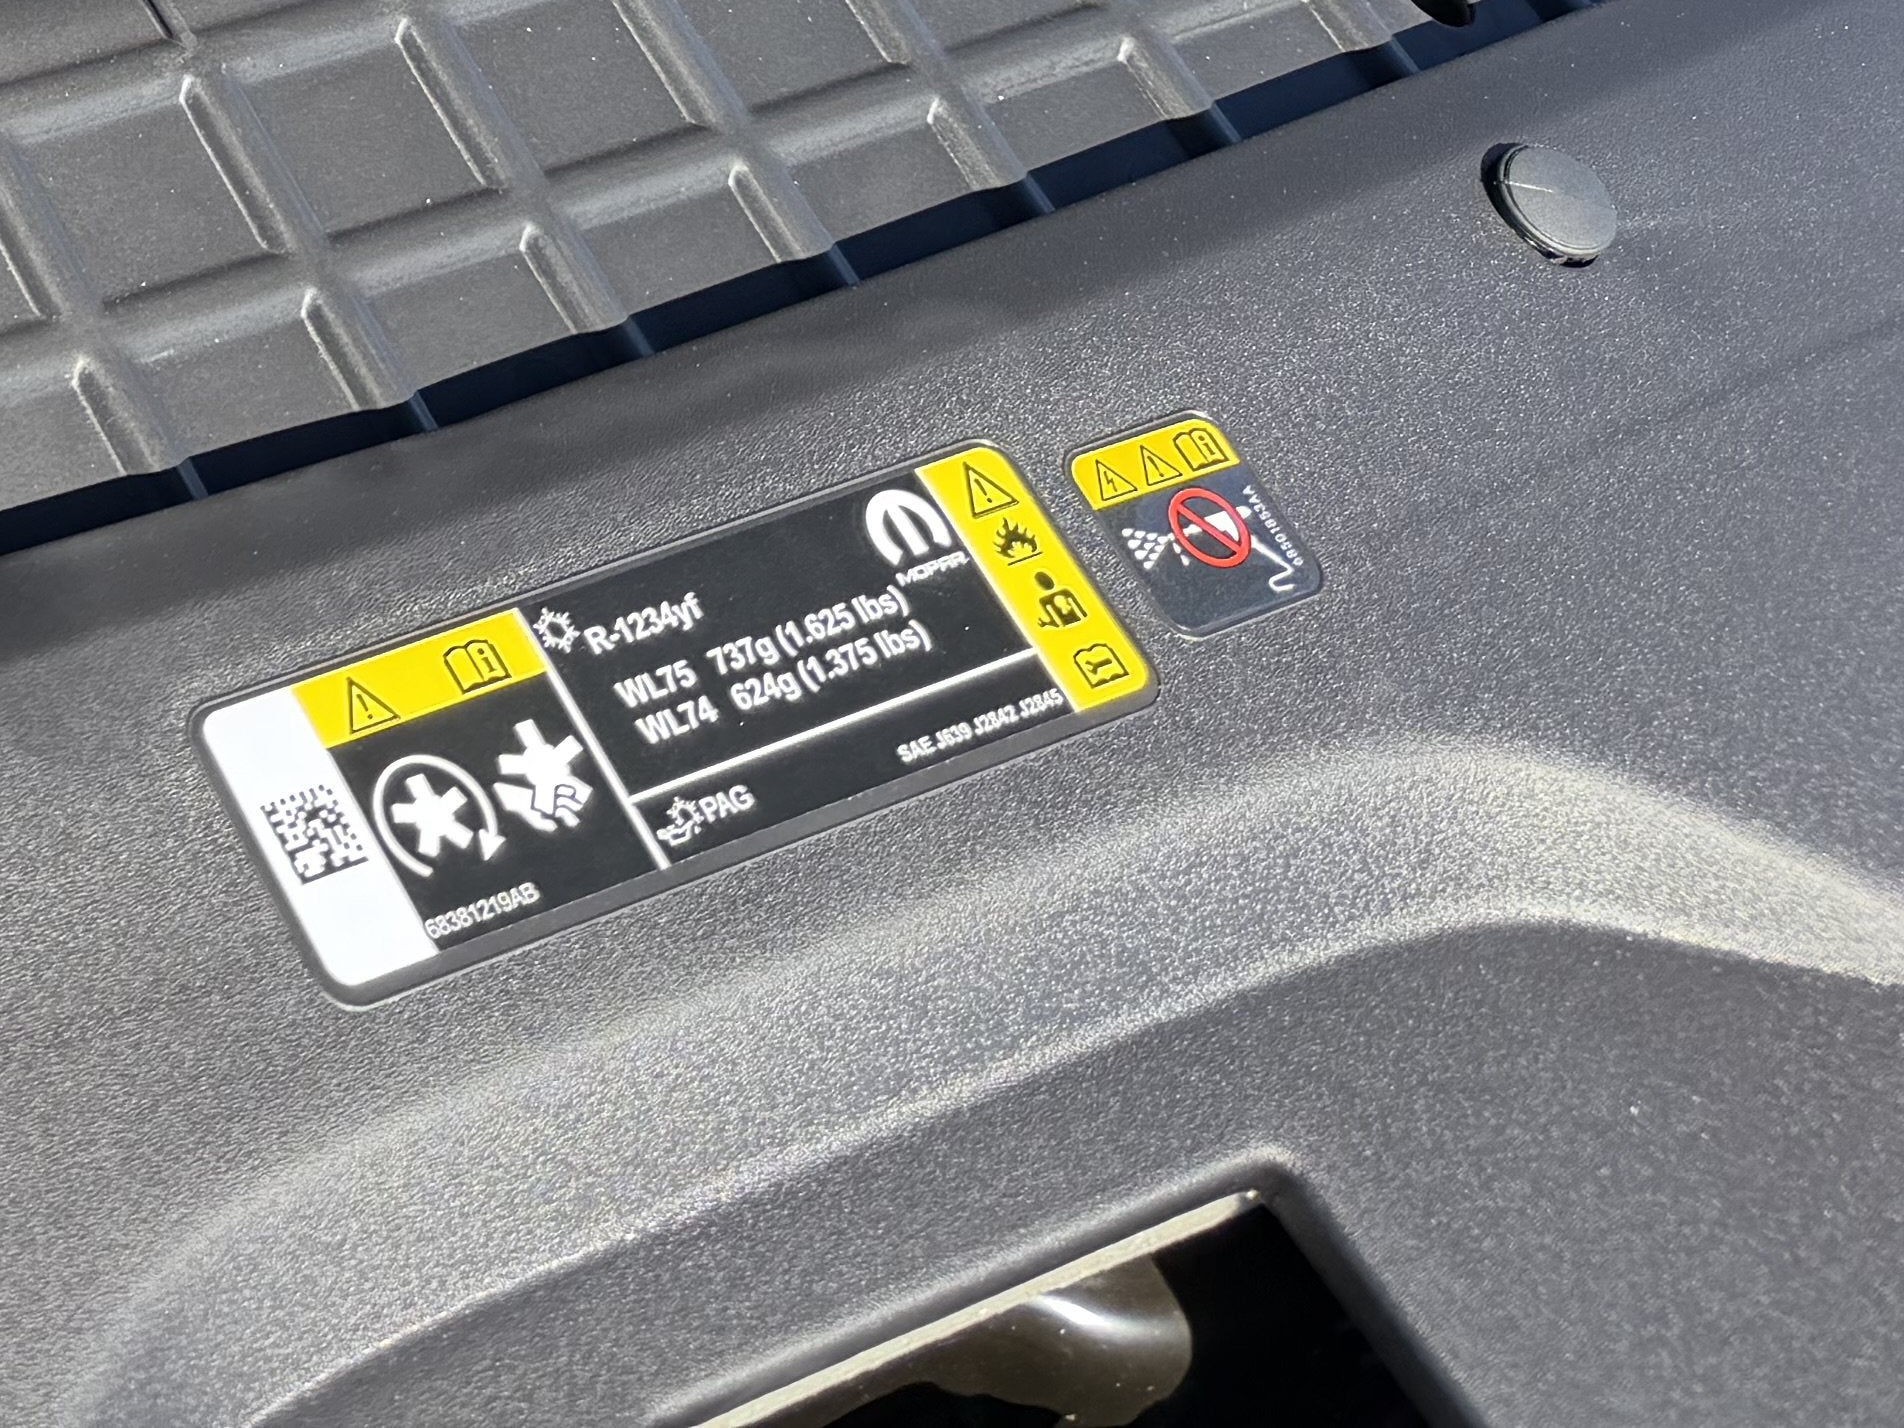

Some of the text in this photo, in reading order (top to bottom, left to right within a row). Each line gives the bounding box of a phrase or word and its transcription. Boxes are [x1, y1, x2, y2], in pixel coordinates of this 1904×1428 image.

[895, 550, 971, 586] MOPAR
[583, 592, 705, 656] R-1234yf
[612, 584, 912, 709] WL75 737g (1.625 lbs)
[633, 619, 934, 746] WL74 624g (1.375 lbs)
[896, 687, 1065, 764] SAE J639 J2842 J2845
[700, 784, 756, 825] PAG
[424, 881, 542, 941] 68381219AB
